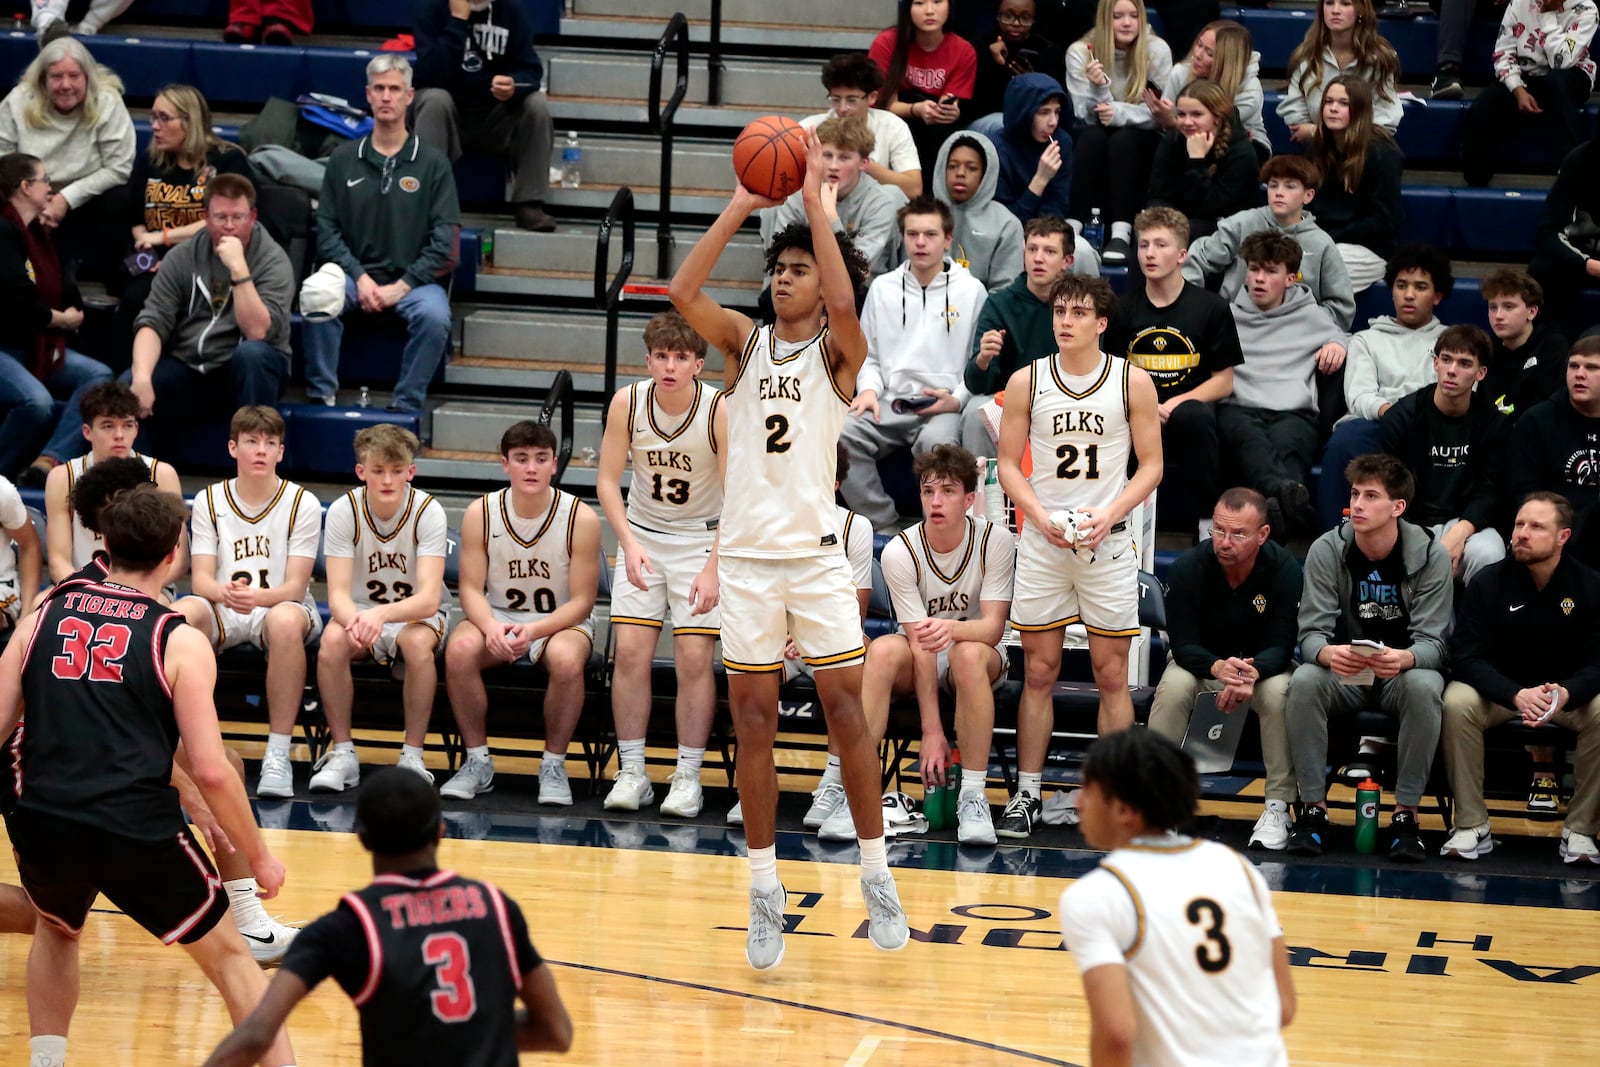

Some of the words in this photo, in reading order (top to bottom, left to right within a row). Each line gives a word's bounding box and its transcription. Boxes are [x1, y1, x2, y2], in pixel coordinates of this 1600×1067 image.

[473, 23, 510, 55] STATE
[759, 376, 801, 400] ELKS
[765, 414, 792, 454] 2
[1052, 411, 1104, 436] ELKS
[647, 450, 692, 472] ELKS
[1056, 444, 1100, 479] 21
[651, 474, 690, 505] 13
[234, 536, 270, 561] ELKS
[368, 551, 407, 574] ELKS
[508, 559, 551, 580] ELKS
[64, 591, 148, 620] TIGERS
[366, 580, 413, 604] 23
[505, 587, 556, 614] 20
[927, 592, 969, 616] ELKS
[51, 616, 132, 683] 32
[1361, 802, 1376, 819] G
[382, 888, 487, 931] TIGERS
[1186, 896, 1232, 974] 3
[422, 931, 478, 1023] 3
